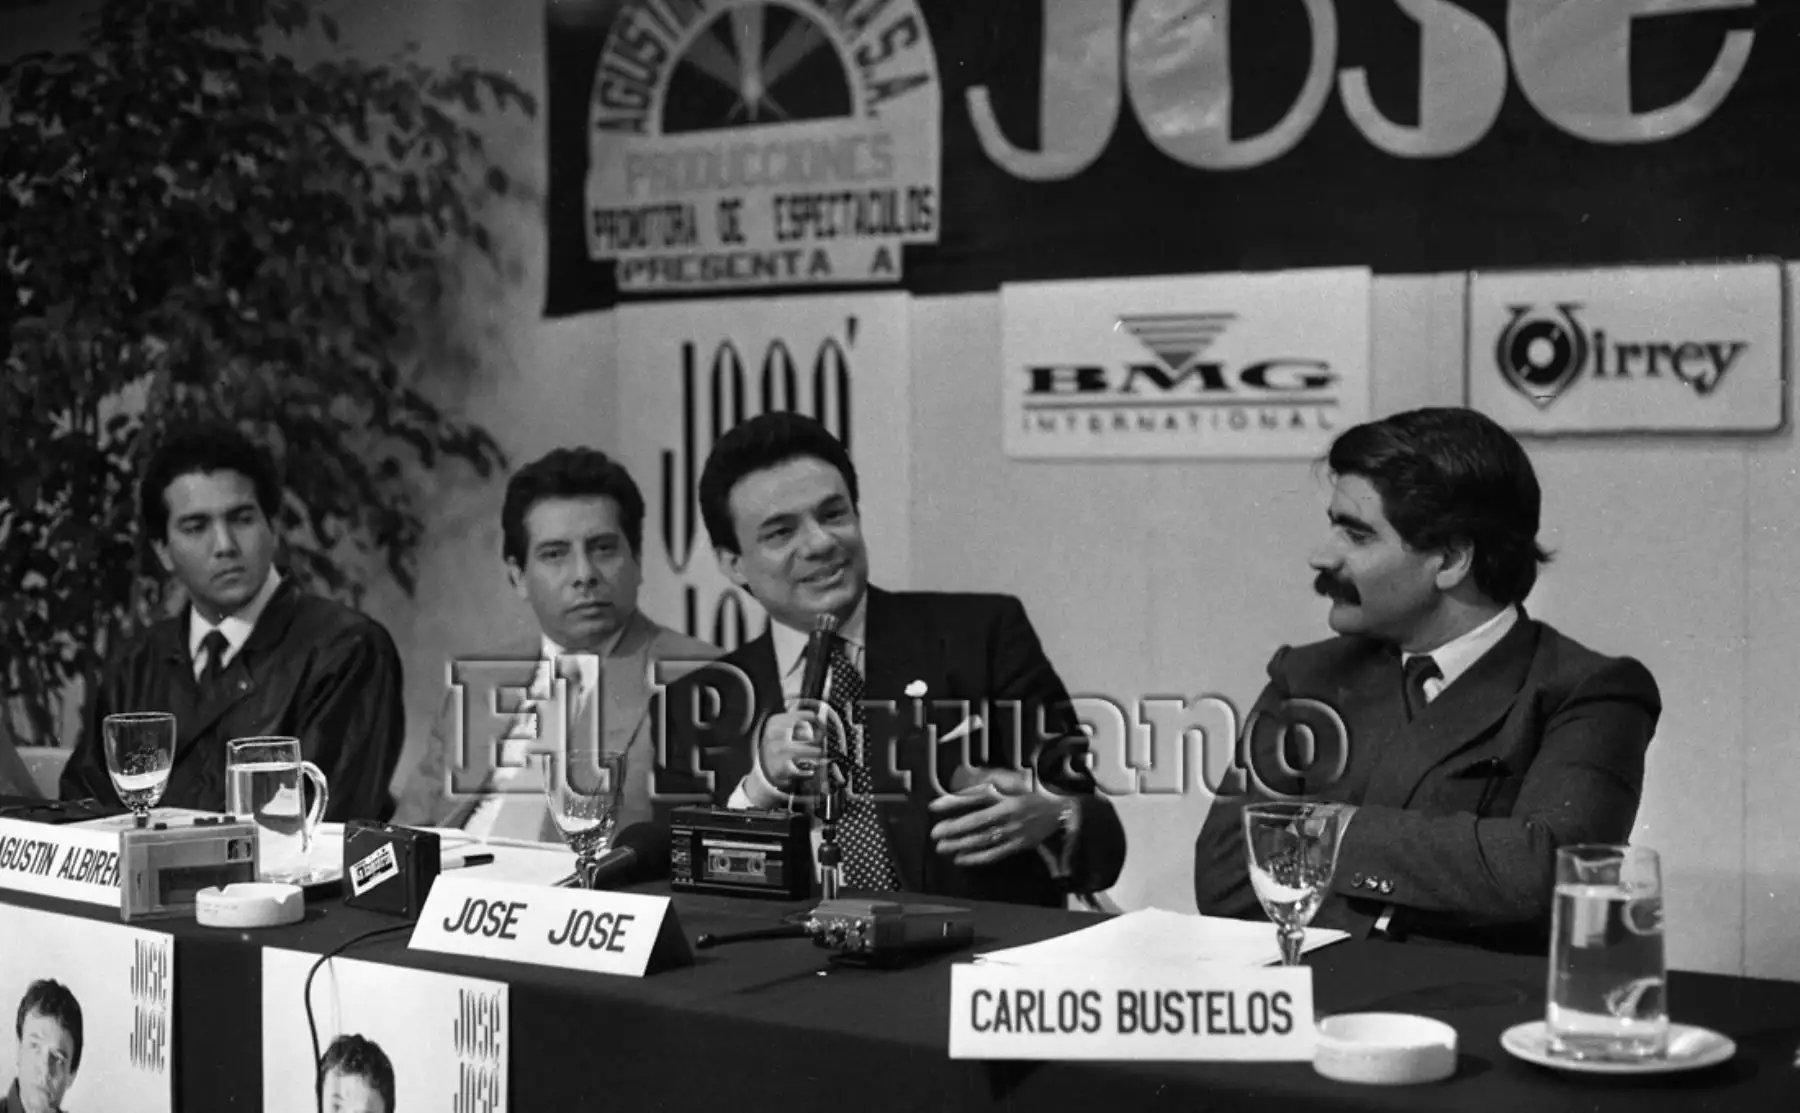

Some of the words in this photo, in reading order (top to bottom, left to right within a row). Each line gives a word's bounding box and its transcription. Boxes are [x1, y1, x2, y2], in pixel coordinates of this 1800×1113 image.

[1023, 357, 1341, 395] BMG
[1021, 408, 1336, 433] INTERNATIONAL
[443, 897, 528, 940] JOSE
[548, 909, 635, 953] JOSE
[970, 989, 1102, 1034] CARLOS
[1116, 990, 1294, 1036] BUSTELOS
